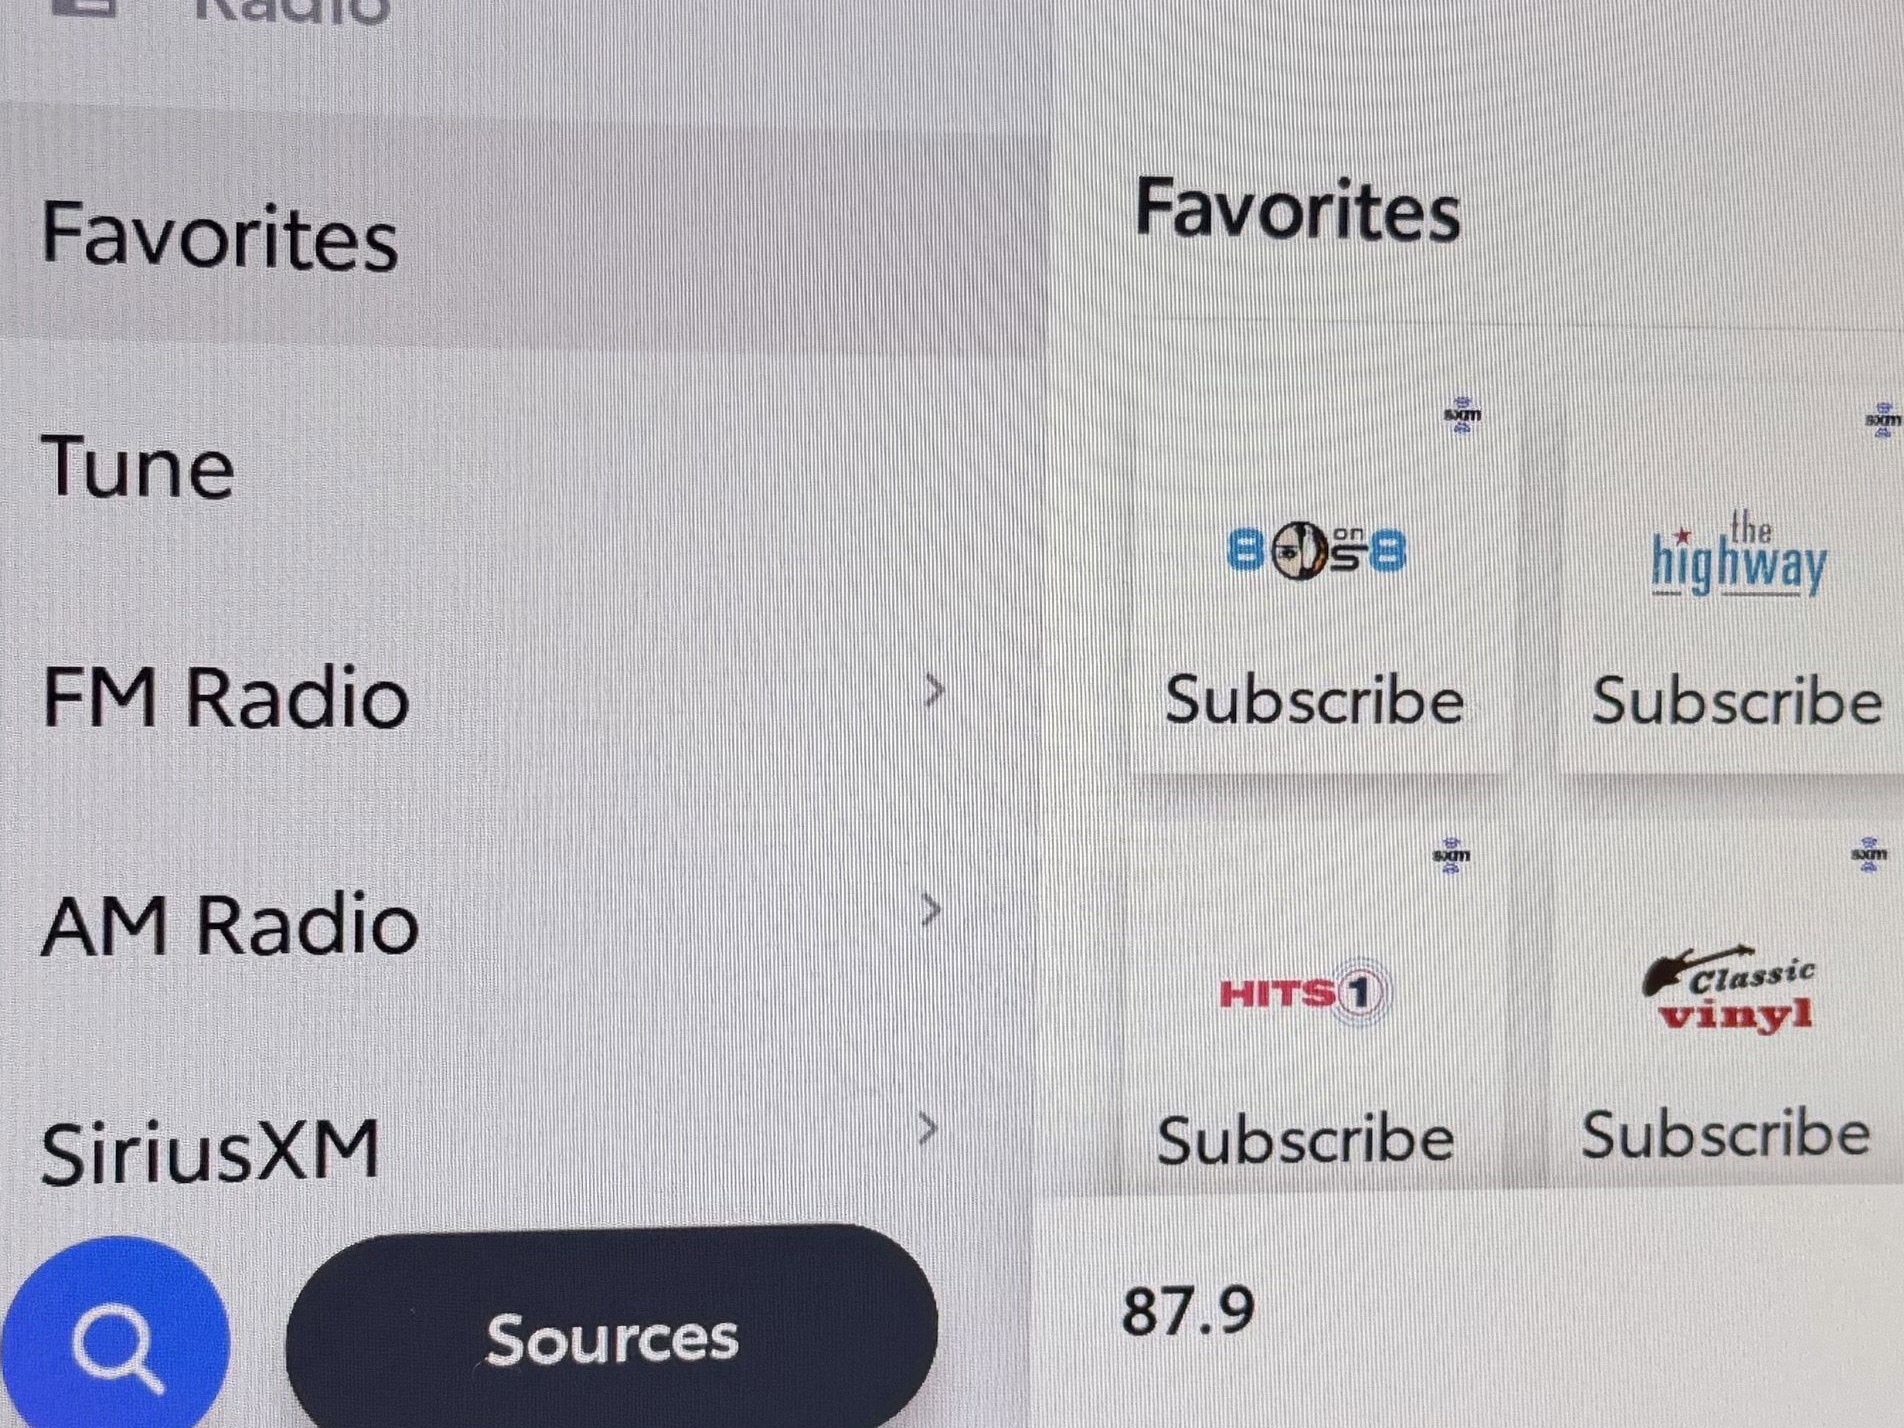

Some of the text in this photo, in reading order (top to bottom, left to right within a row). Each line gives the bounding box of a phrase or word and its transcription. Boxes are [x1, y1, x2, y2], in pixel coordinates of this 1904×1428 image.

[40, 199, 400, 273] Favorites
[1134, 176, 1463, 245] Favorites
[40, 434, 236, 501] Tune
[1731, 508, 1772, 544] the
[1651, 527, 1828, 598] highway
[43, 663, 411, 731] FM Radio
[1166, 672, 1465, 729] Subscribe
[1592, 674, 1883, 729] Subscribe
[40, 889, 420, 957] AM Radio
[1688, 958, 1816, 994] Classic
[1658, 997, 1813, 1036] vinyl
[40, 1117, 382, 1186] SiriusXM
[1156, 1110, 1456, 1166] Subscribe
[1581, 1105, 1872, 1160] Subscribe
[484, 1310, 741, 1369] Sources
[1120, 1283, 1257, 1338] 87.9
